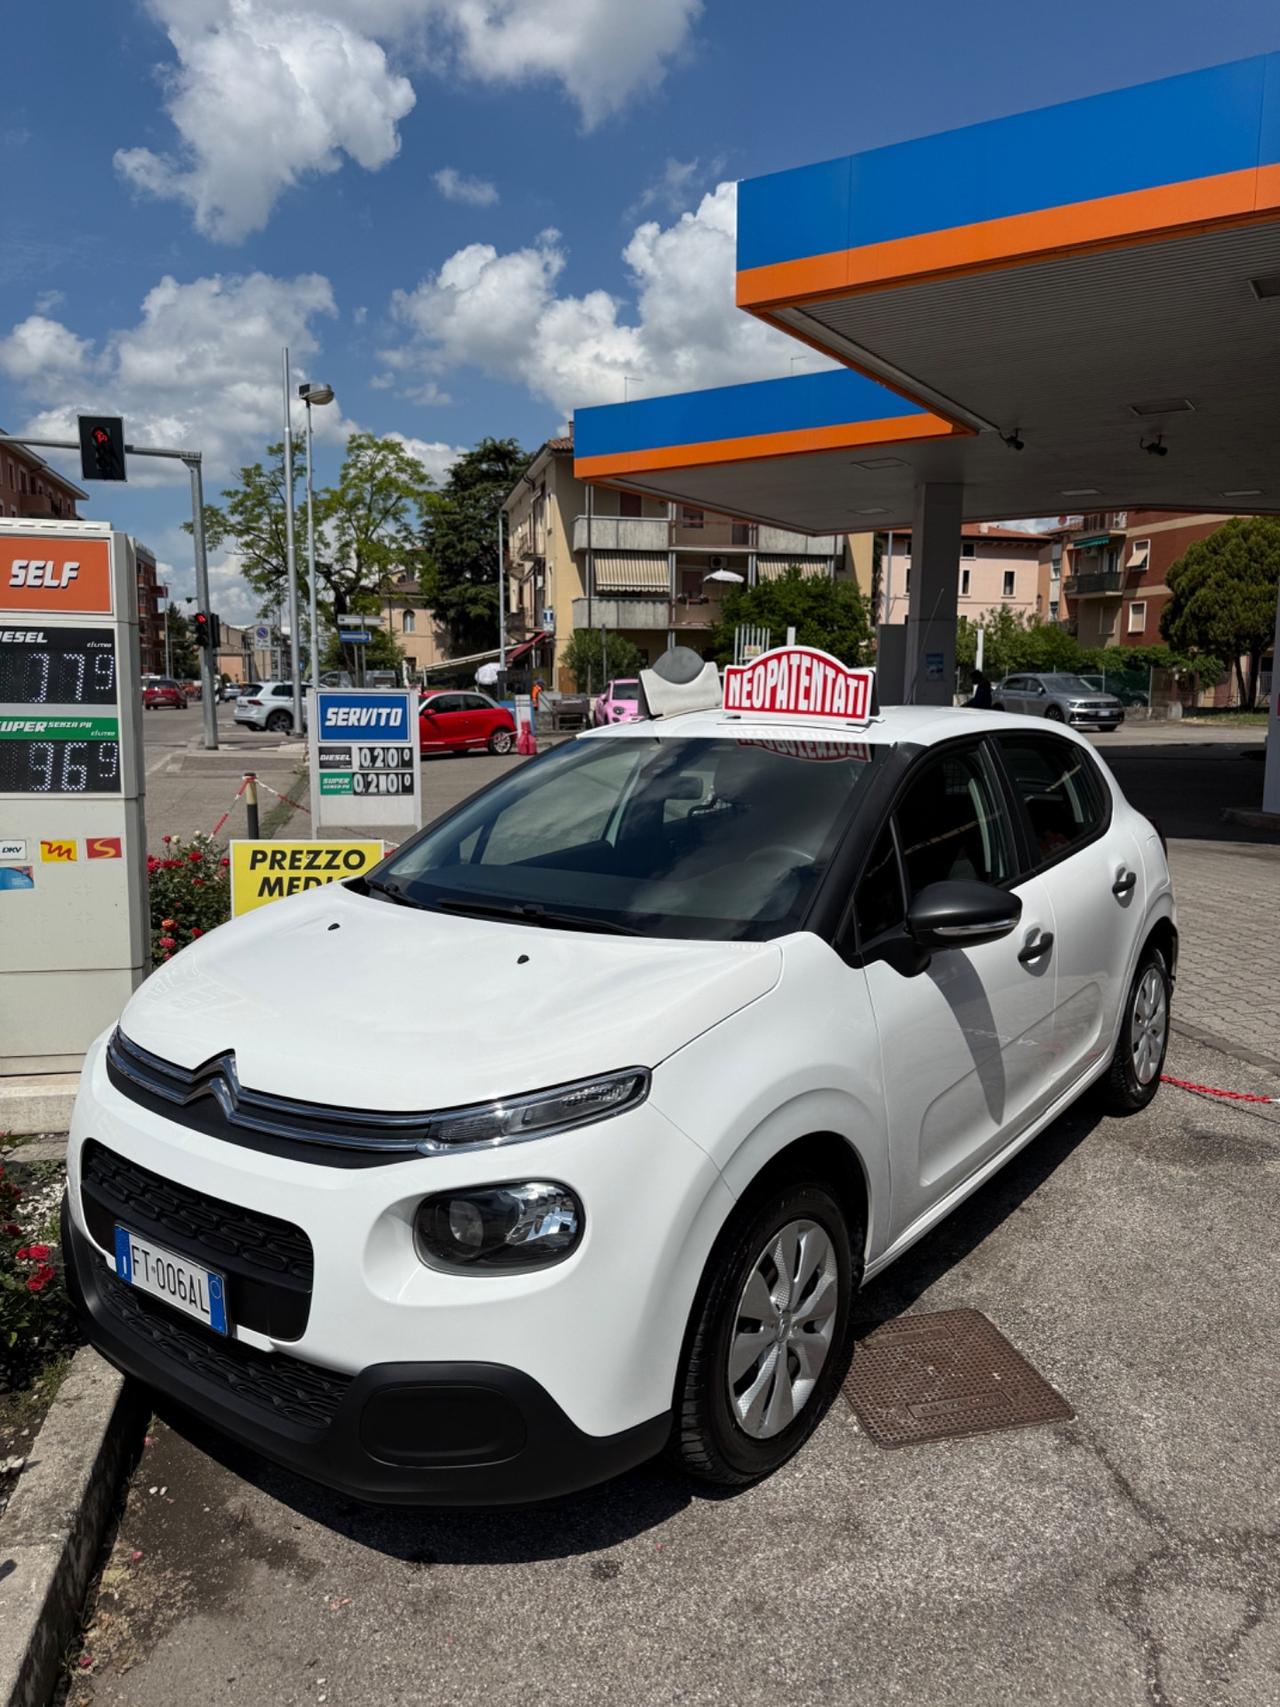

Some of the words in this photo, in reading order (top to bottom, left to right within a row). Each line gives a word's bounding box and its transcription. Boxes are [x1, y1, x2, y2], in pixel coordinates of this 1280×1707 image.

[9, 559, 80, 589] SELF
[728, 653, 865, 715] NEOPATENTATI
[0, 721, 47, 732] UPER
[325, 707, 403, 727] SERVITO
[250, 849, 366, 871] PREZZO
